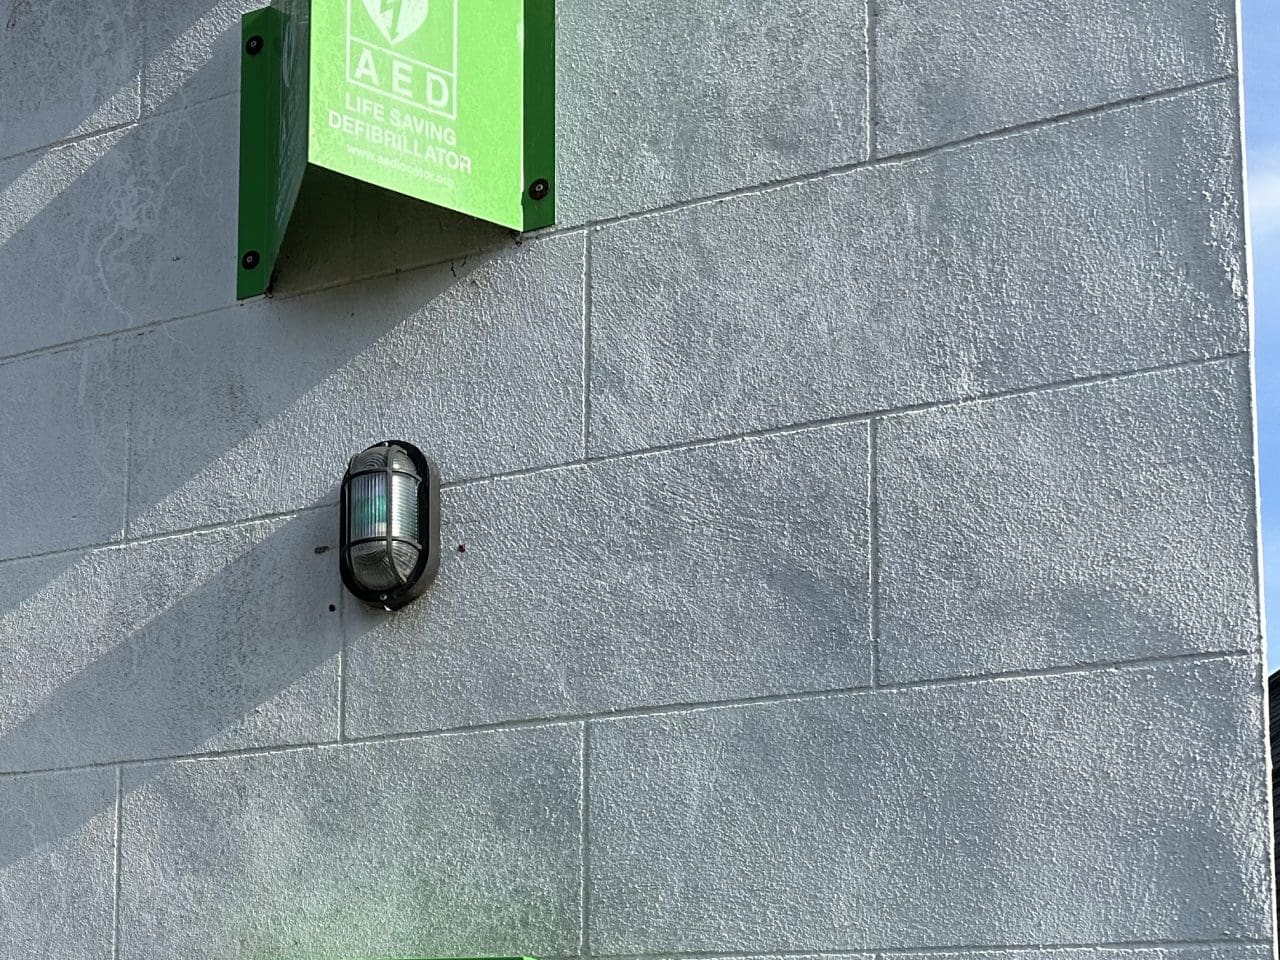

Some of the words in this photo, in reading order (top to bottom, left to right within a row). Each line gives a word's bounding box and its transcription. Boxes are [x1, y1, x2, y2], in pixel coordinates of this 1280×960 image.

[328, 111, 471, 175] DEFIBRILLATOR
[346, 92, 384, 122] LIFE
[390, 108, 456, 145] SAVING
